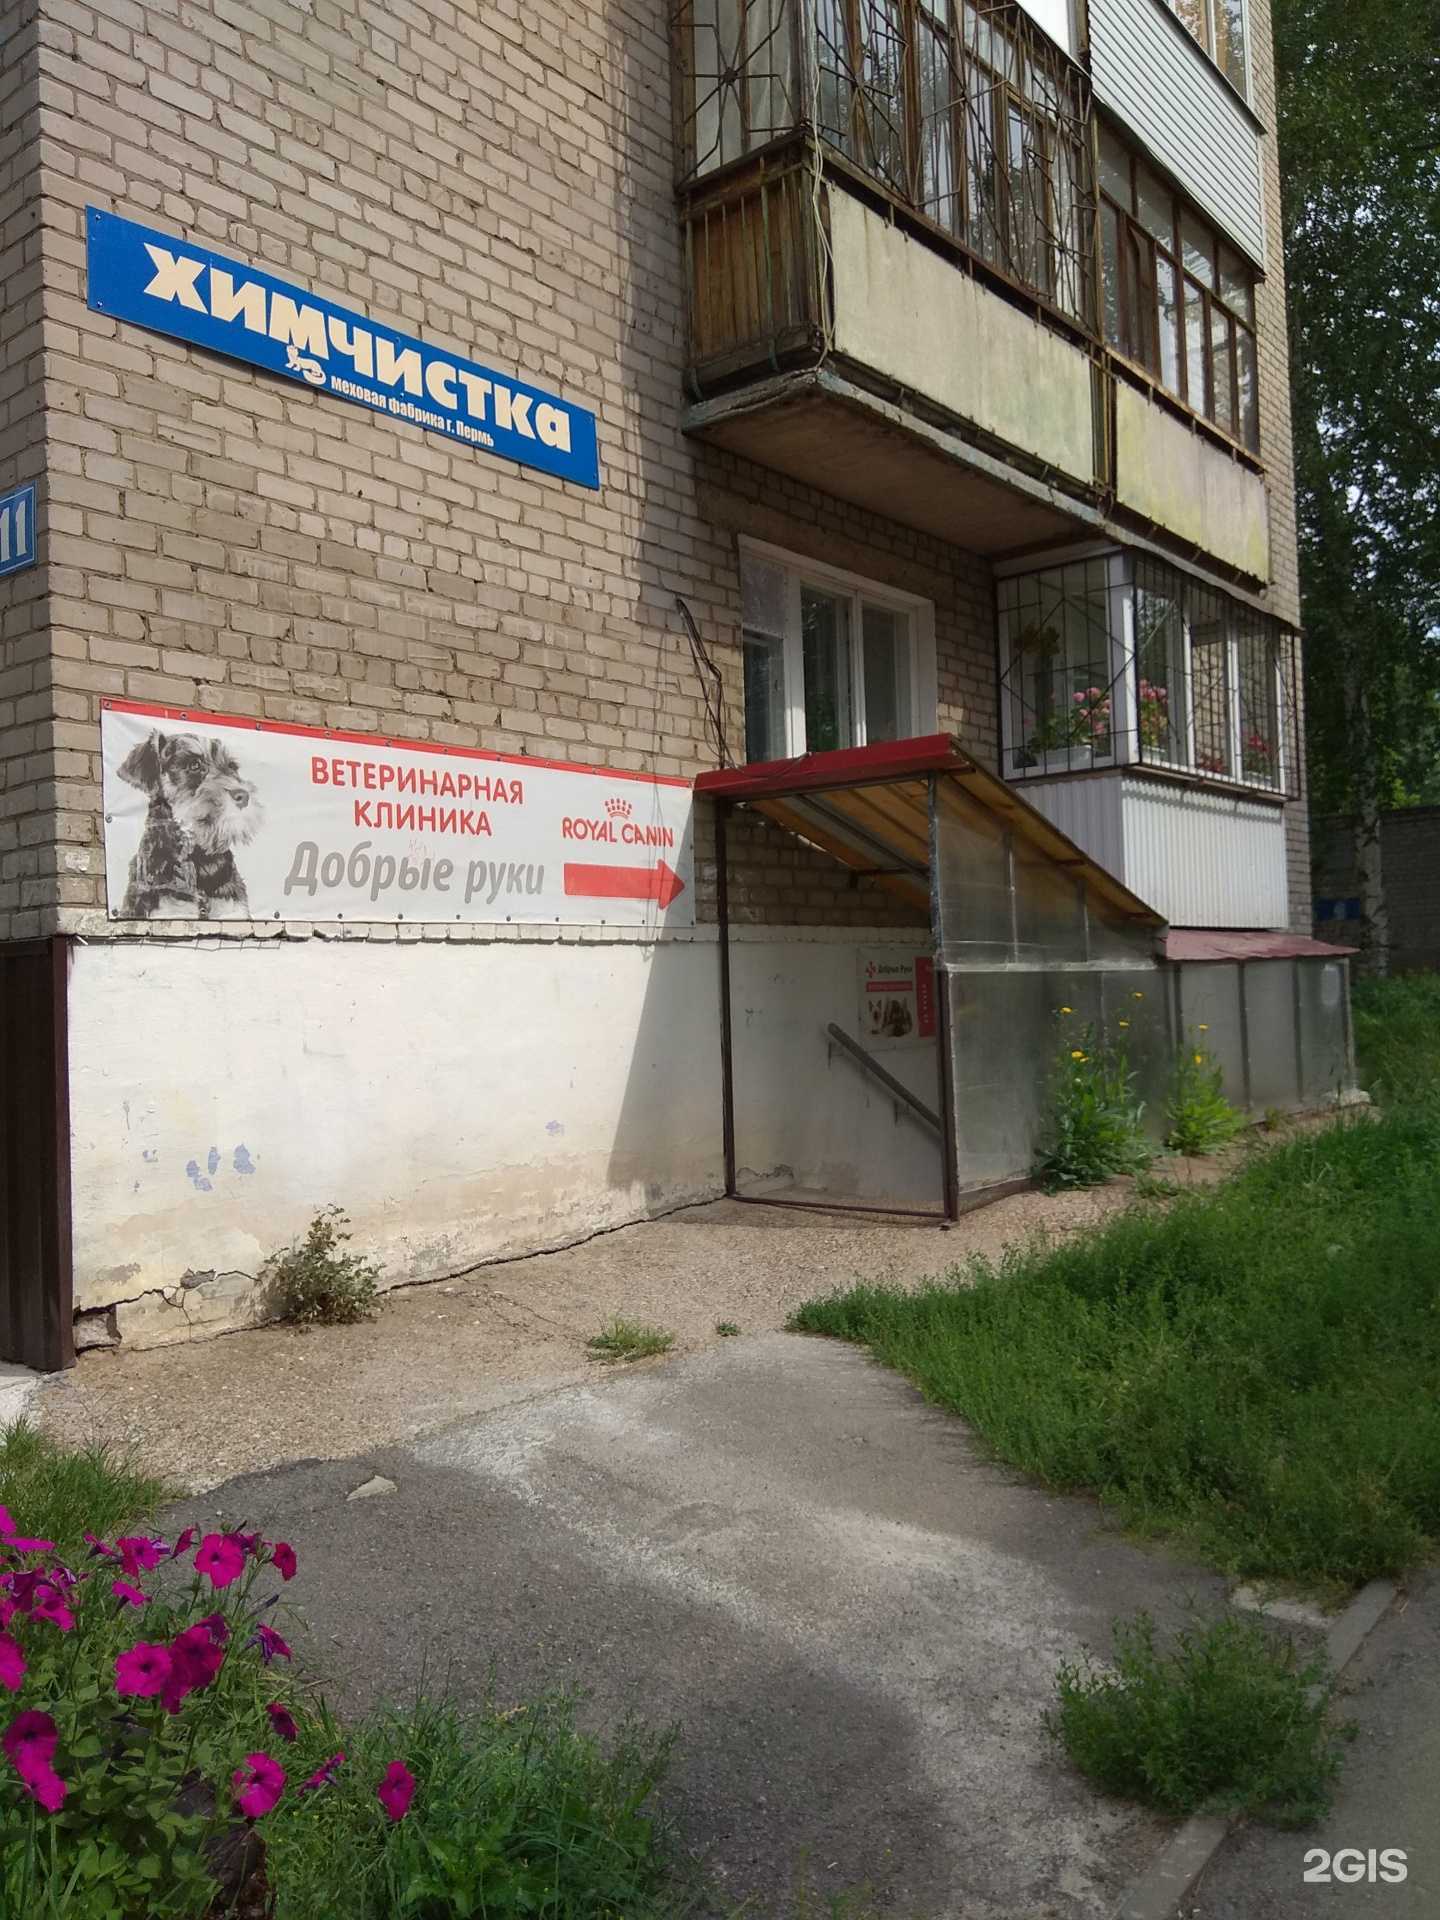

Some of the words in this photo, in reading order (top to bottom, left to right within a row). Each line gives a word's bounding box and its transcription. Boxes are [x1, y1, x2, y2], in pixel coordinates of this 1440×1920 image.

[331, 375, 386, 407] меховая
[389, 397, 445, 431] фабрика
[456, 420, 495, 447] Пермь
[311, 756, 524, 805] ВЕТЕРИНАРНАЯ
[354, 800, 492, 837] КЛИНИКА
[562, 816, 617, 843] ROYAL
[621, 823, 673, 848] CANIN
[284, 841, 454, 902] Добрые
[464, 860, 545, 904] руки
